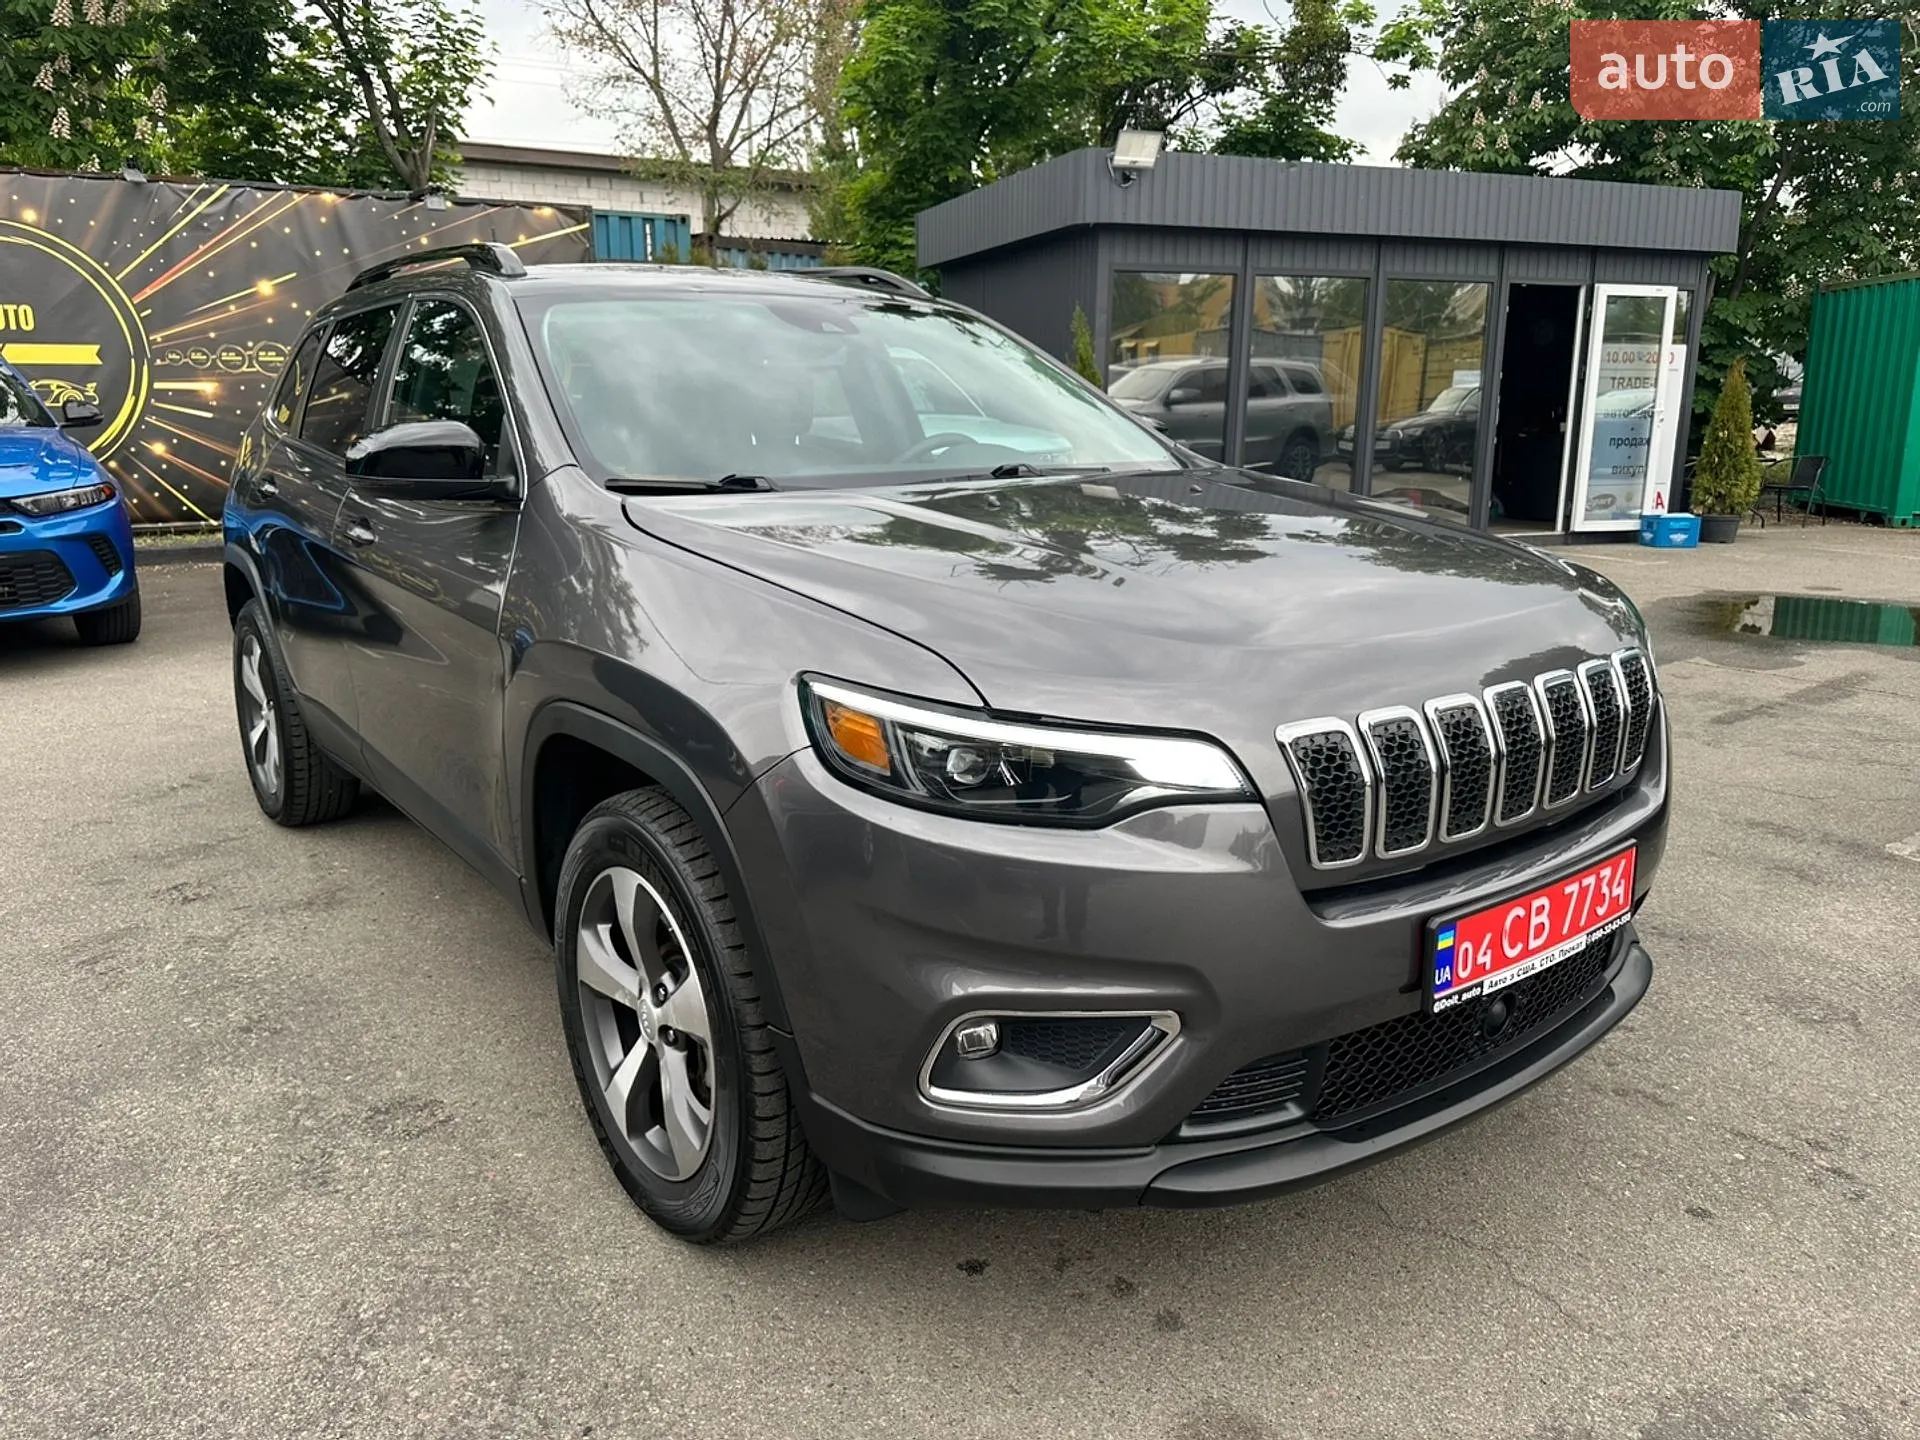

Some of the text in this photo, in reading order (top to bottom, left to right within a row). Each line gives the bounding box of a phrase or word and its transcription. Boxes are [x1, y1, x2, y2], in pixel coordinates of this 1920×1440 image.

[1456, 931, 1493, 979] 04
[1501, 896, 1551, 959] CB
[1561, 858, 1627, 936] 7734
[1434, 965, 1451, 985] UA
